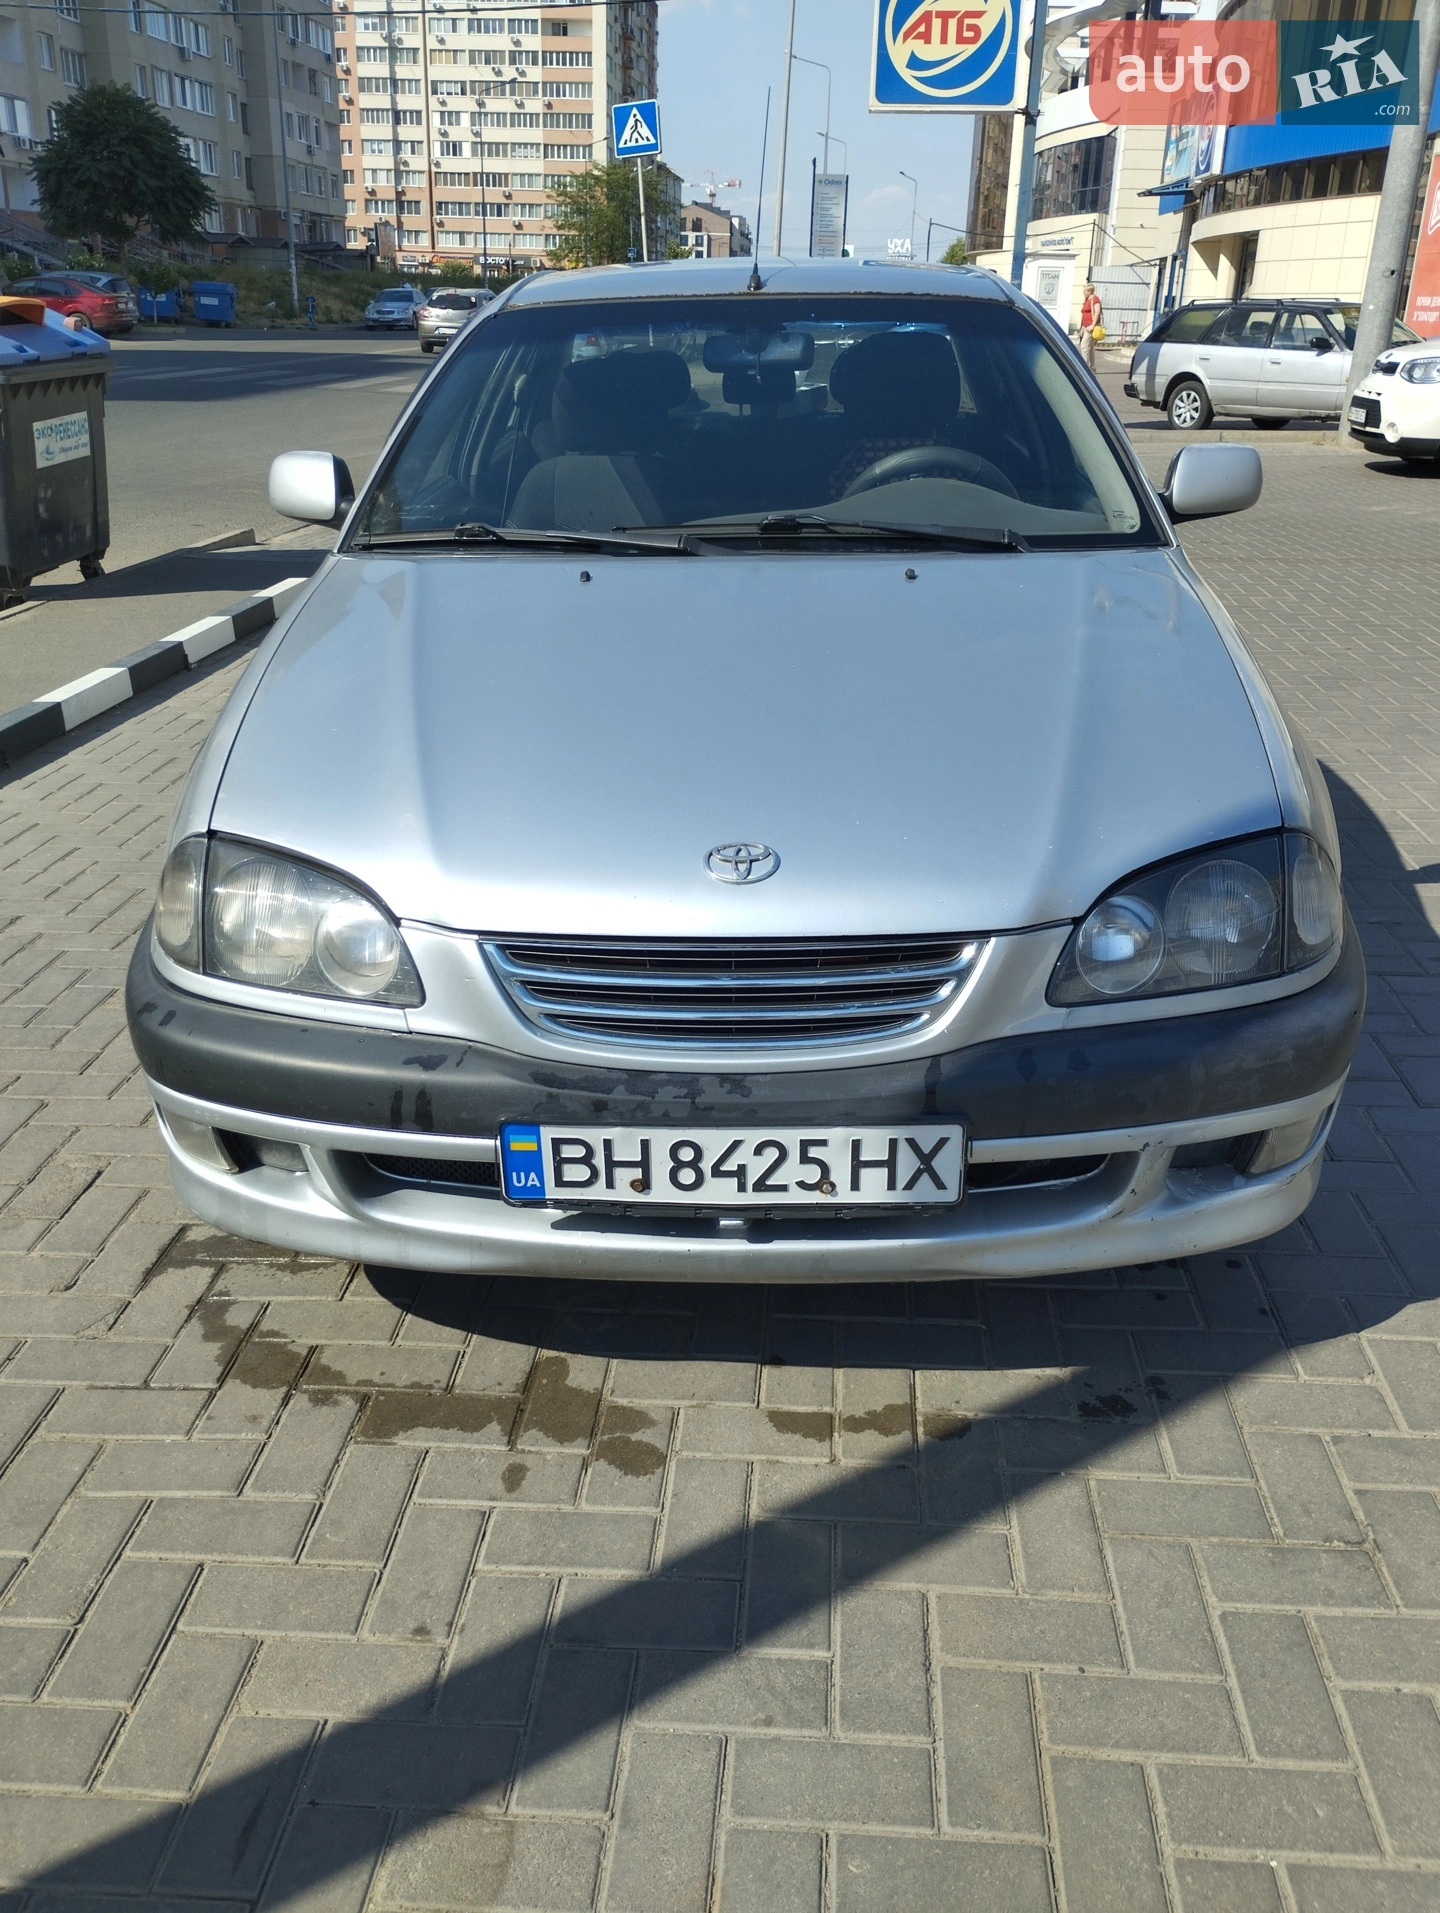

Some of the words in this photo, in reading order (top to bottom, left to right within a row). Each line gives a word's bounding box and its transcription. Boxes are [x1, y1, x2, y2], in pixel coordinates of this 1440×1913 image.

[902, 10, 988, 45] АТБ
[823, 178, 843, 186] Odrex
[887, 238, 912, 254] УХА
[550, 1137, 651, 1190] BH
[668, 1138, 829, 1193] 8425
[849, 1137, 951, 1192] HX
[512, 1171, 541, 1188] UA
